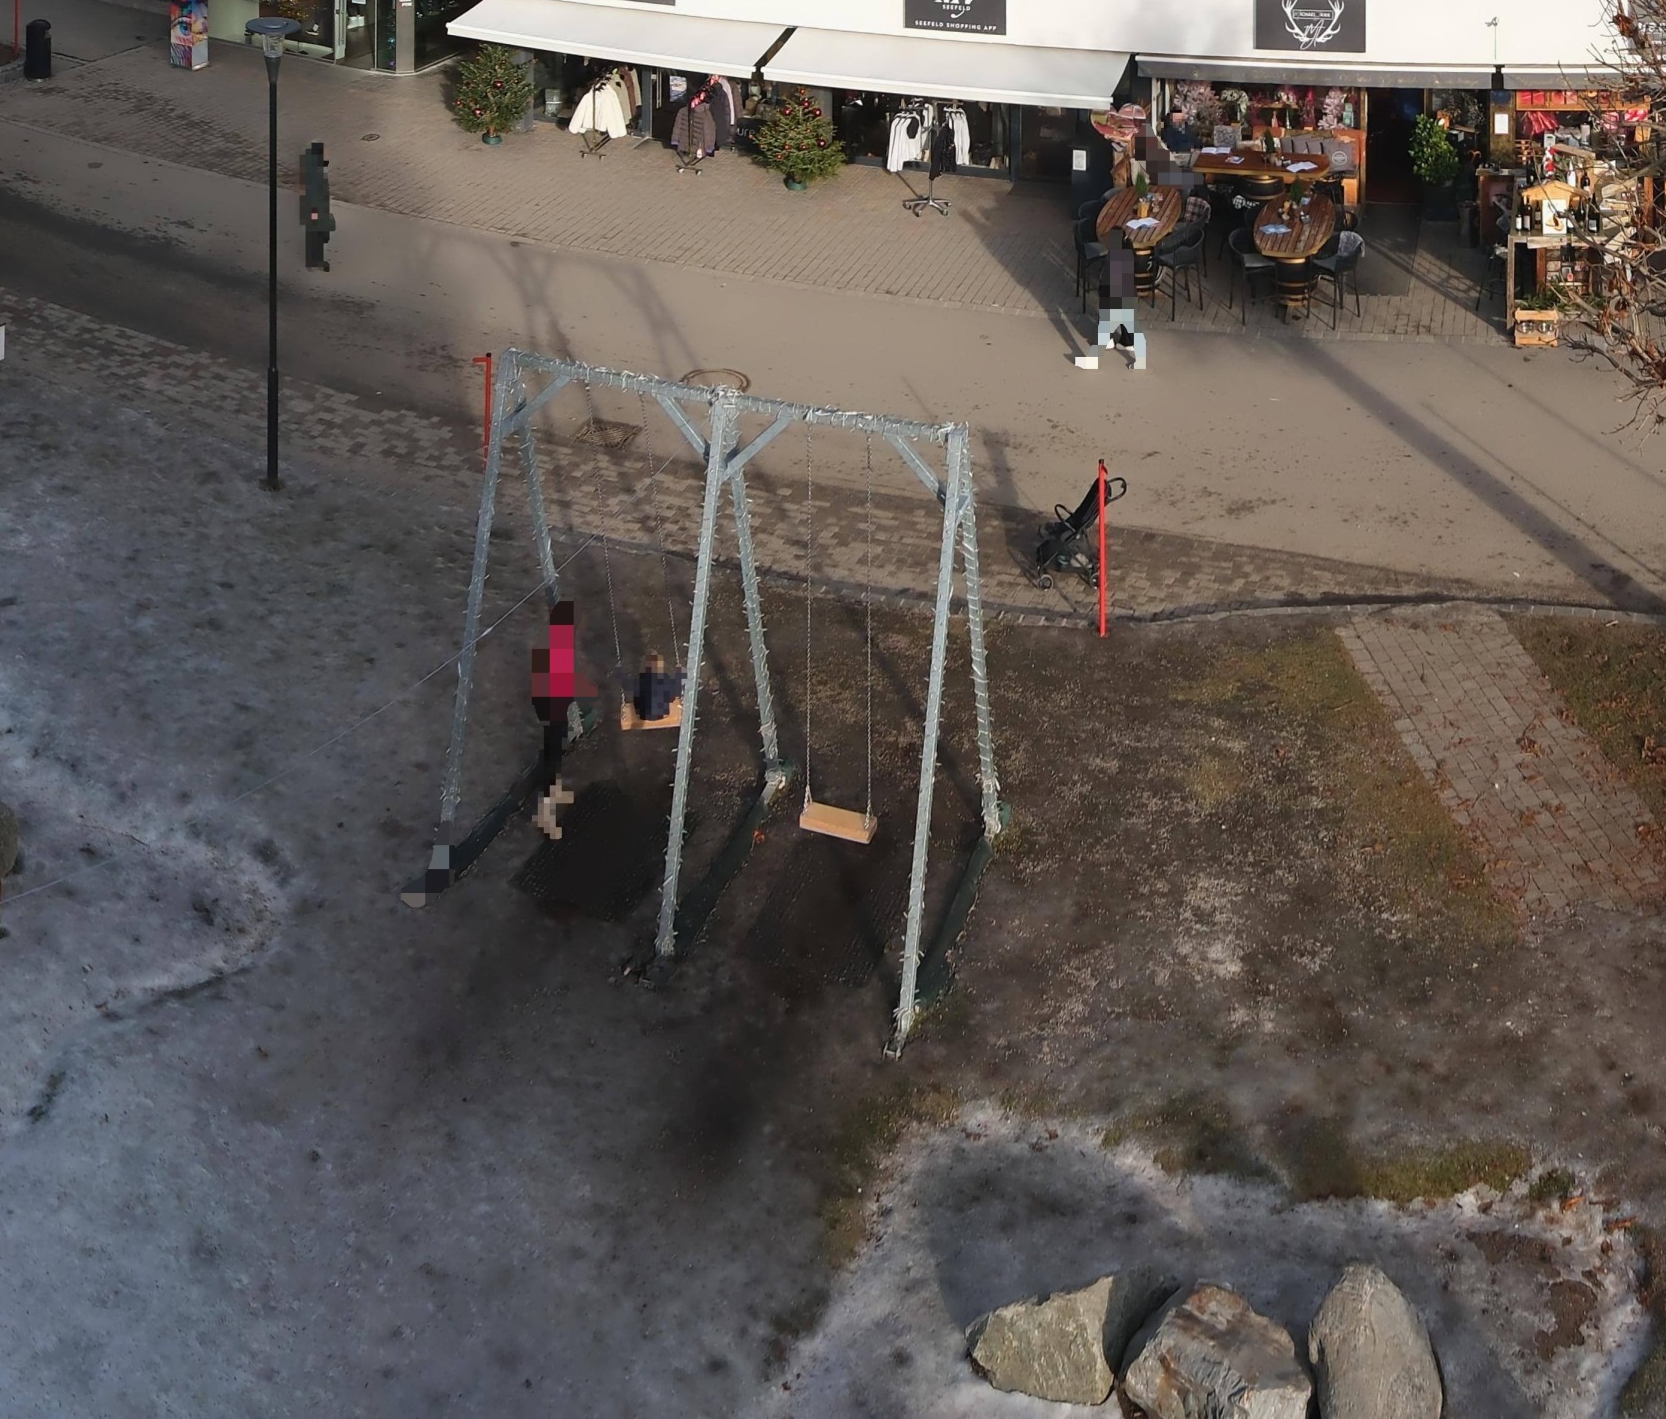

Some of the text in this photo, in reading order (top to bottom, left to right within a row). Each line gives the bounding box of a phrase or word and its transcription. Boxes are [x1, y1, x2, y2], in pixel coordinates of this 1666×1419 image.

[942, 4, 971, 12] SEEFELD
[915, 20, 944, 28] SEEFELD
[946, 22, 981, 30] SHOPPING
